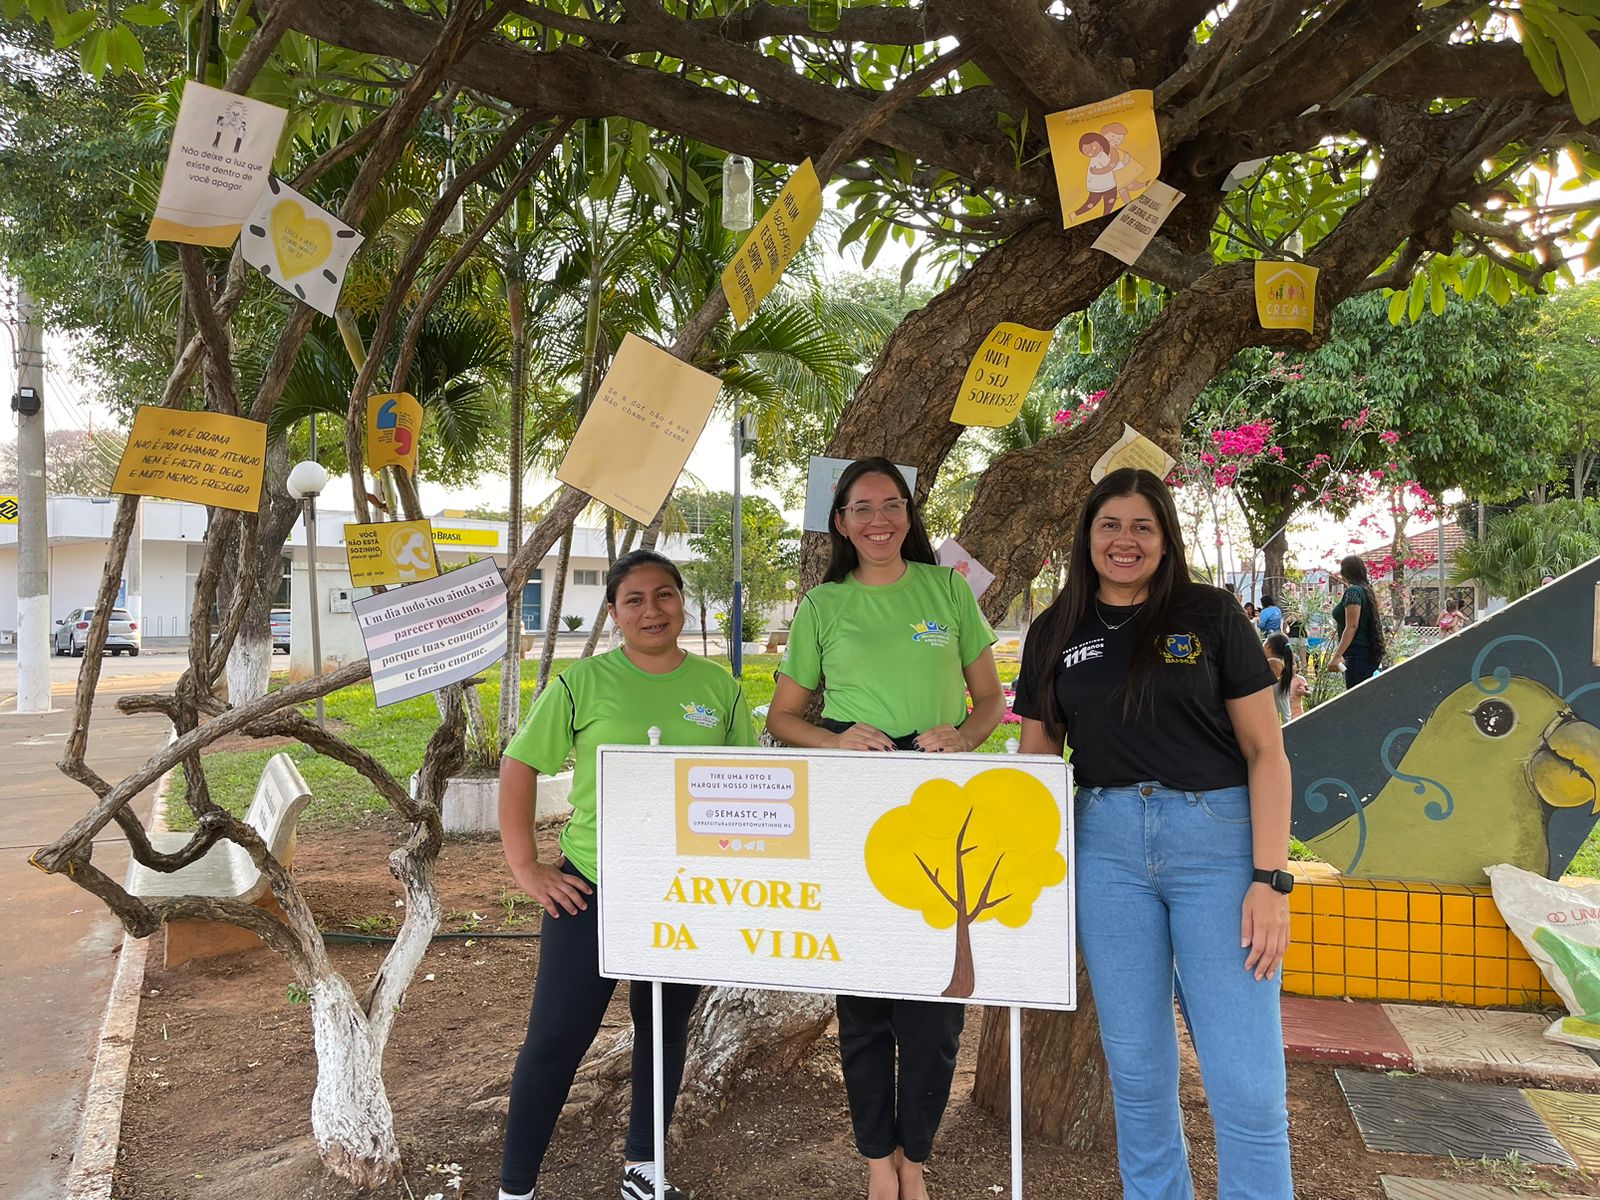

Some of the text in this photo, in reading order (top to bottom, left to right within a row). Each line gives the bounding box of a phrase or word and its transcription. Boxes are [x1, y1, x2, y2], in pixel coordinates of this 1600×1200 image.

[181, 145, 198, 157] Não
[200, 148, 223, 162] deixe
[233, 157, 246, 167] luz
[248, 162, 263, 173] que
[186, 159, 253, 181] existe dentro de
[188, 173, 243, 192] você apagar.
[788, 203, 800, 222] UM
[760, 224, 770, 240] TE
[748, 241, 764, 273] SEMPRE
[737, 270, 750, 290] FOR
[991, 330, 1012, 347] POR
[974, 368, 1008, 388] O SEU
[608, 386, 618, 396] Se
[630, 399, 646, 412] dor
[650, 409, 664, 422] não
[676, 424, 690, 434] sua
[622, 405, 646, 422] chame
[650, 420, 660, 430] de
[664, 428, 686, 443] drama
[198, 431, 230, 445] DRAMA
[162, 442, 178, 450] PRA
[180, 444, 218, 458] CHAMAR
[142, 455, 161, 465] NEM
[171, 460, 200, 469] FALTA
[203, 464, 216, 473] DE
[219, 467, 244, 478] DEUS
[129, 468, 250, 494] E MUITO MENOS FRESCURA
[358, 530, 378, 538] VOCÊ
[437, 532, 462, 540] BRASIL
[364, 576, 495, 626] Um dia tudo isto ainda vai
[394, 622, 434, 642] parecer
[382, 619, 498, 668] porque tuas conquistas
[405, 646, 487, 681] te farão enorme.
[710, 772, 725, 780] TIRE
[722, 782, 748, 790] NOSSO
[705, 809, 777, 821] @SEMASTC_PM
[662, 866, 822, 912] ÁRVORE
[650, 921, 842, 962] DA VIDA
